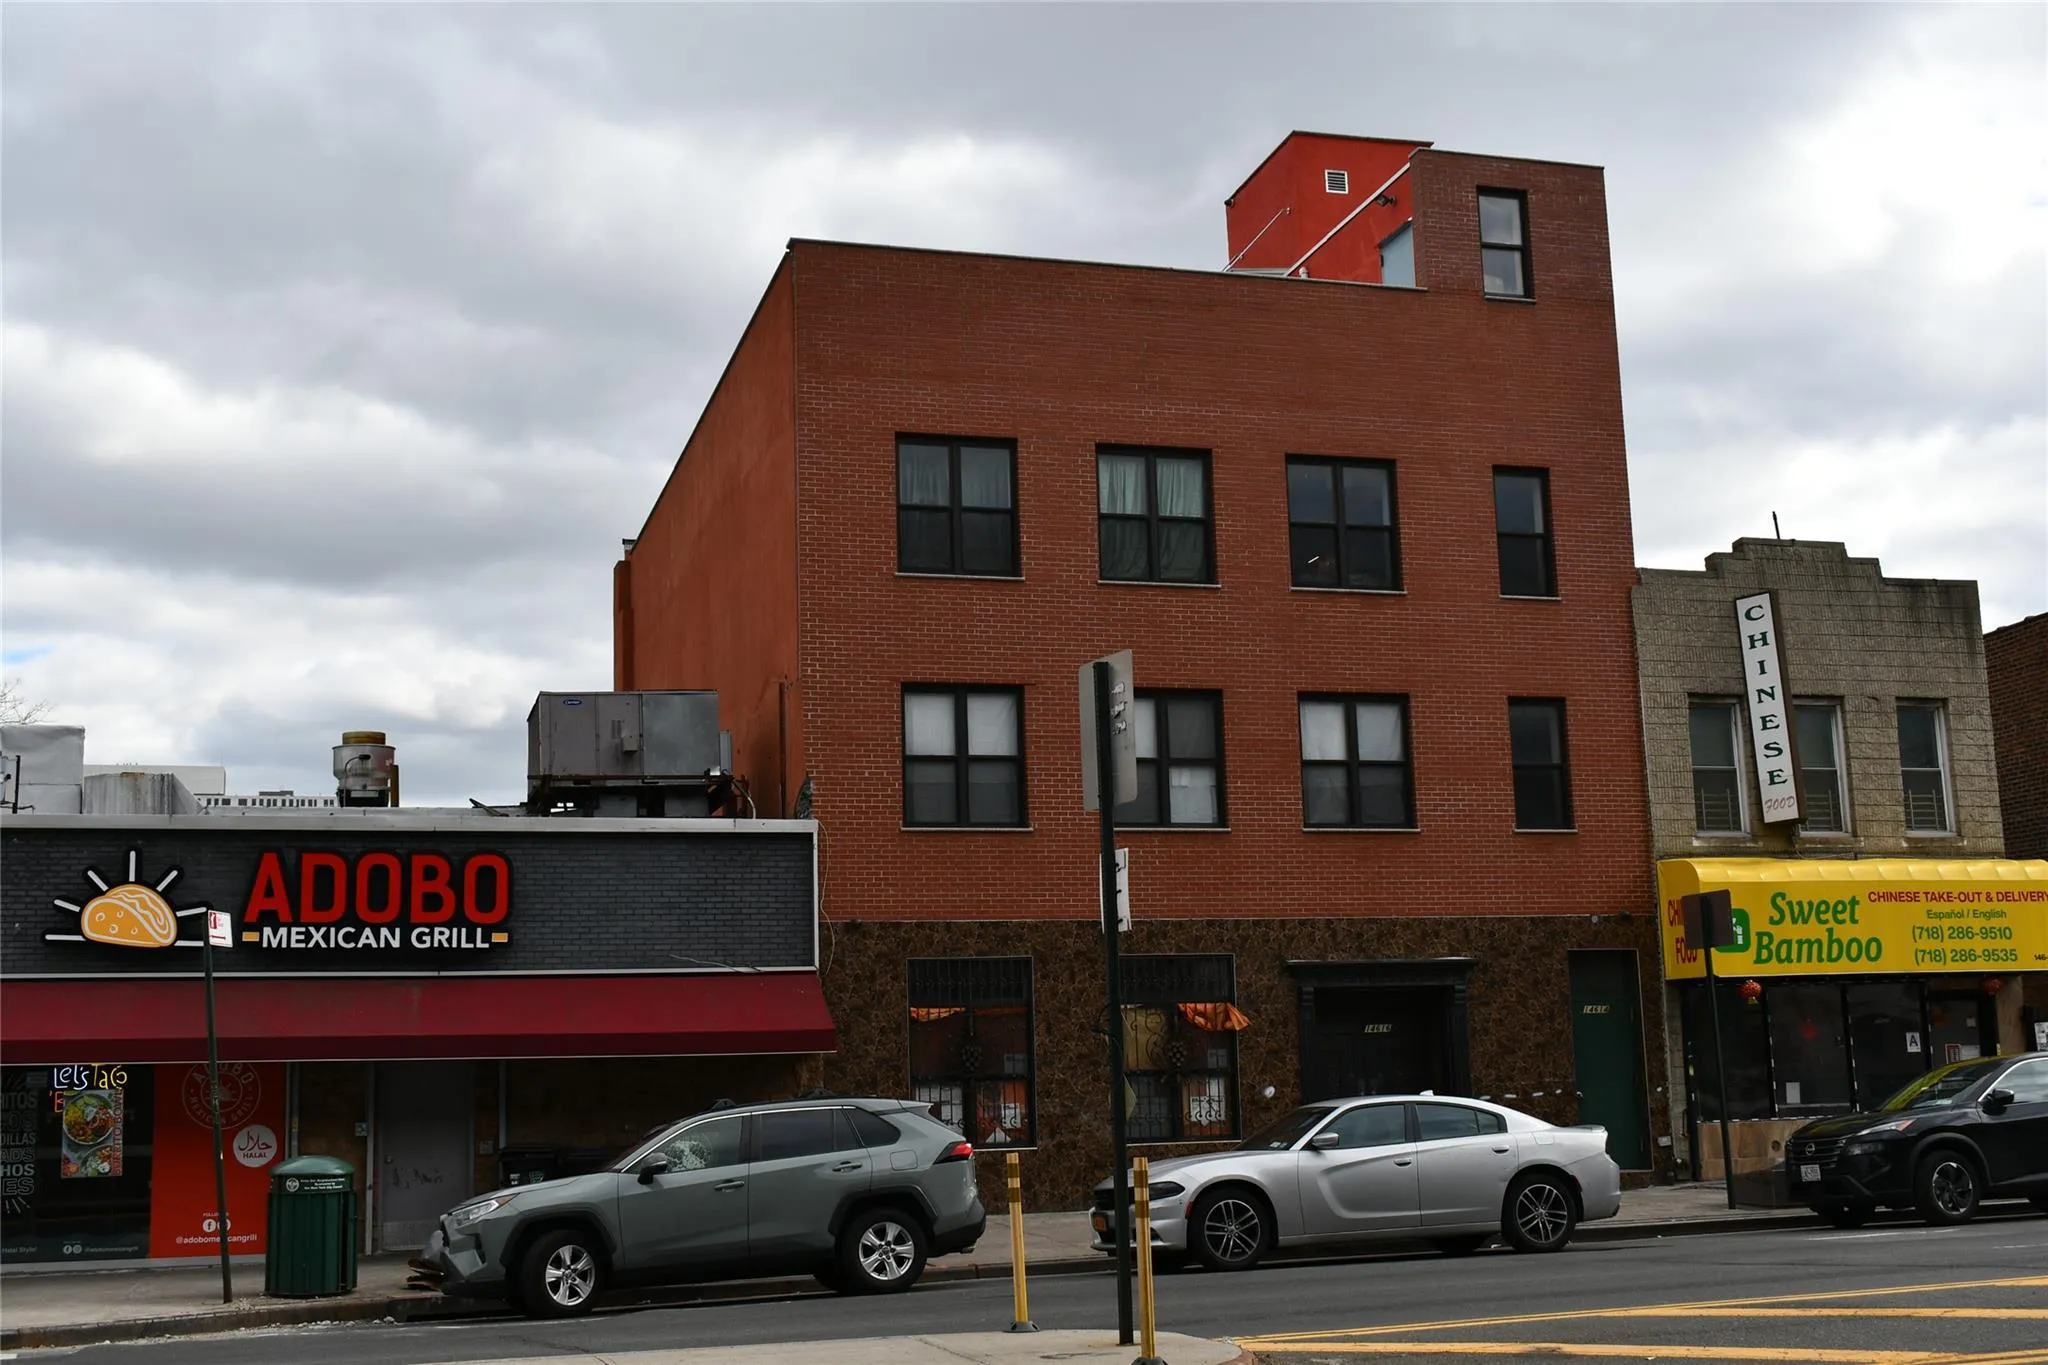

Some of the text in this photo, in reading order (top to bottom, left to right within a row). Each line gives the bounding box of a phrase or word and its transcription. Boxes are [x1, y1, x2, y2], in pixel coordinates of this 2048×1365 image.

[1744, 604, 1788, 786] CHINESE
[1764, 796, 1796, 814] FOOD
[243, 851, 509, 924] ADOBO
[1867, 891, 1921, 904] CHINESE
[1922, 891, 1983, 904] TAKE-OUT
[1985, 892, 1994, 903] &
[1768, 890, 1861, 926] Sweet
[1926, 908, 1965, 921] Español
[1972, 909, 2008, 921] English
[262, 926, 490, 950] MEXICAN GRILL
[1912, 924, 2013, 944] (718) 286-9510
[1753, 927, 1883, 966] Bamboo
[1914, 946, 2018, 966] (718) 286-9535
[1909, 1034, 1918, 1047] A
[238, 1129, 273, 1152] حلال
[176, 1233, 258, 1245] @adobomecangrill
